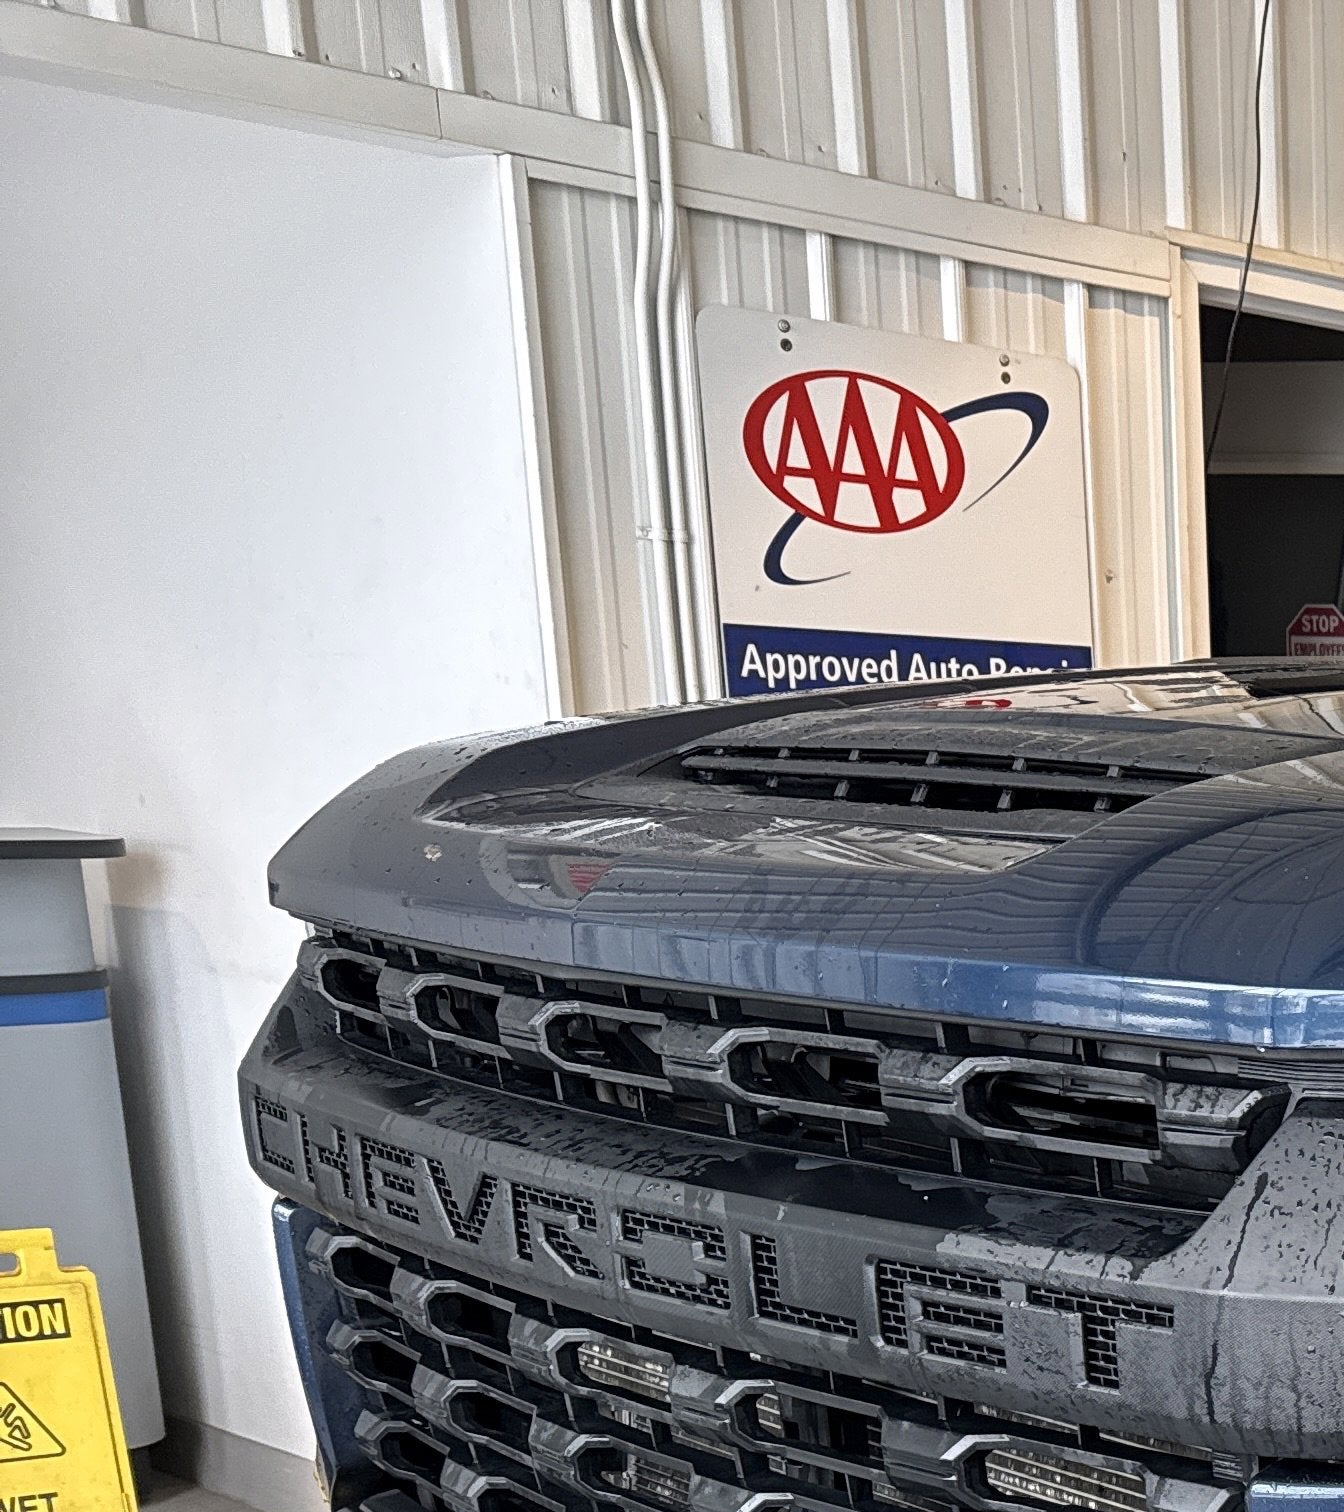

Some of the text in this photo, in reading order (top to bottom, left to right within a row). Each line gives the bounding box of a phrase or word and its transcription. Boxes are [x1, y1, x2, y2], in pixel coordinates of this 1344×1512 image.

[773, 374, 950, 531] AAA
[1301, 614, 1340, 633] STOP
[740, 643, 900, 689] Approved
[252, 1092, 1176, 1393] CHEVROLET
[0, 1301, 67, 1340] ION
